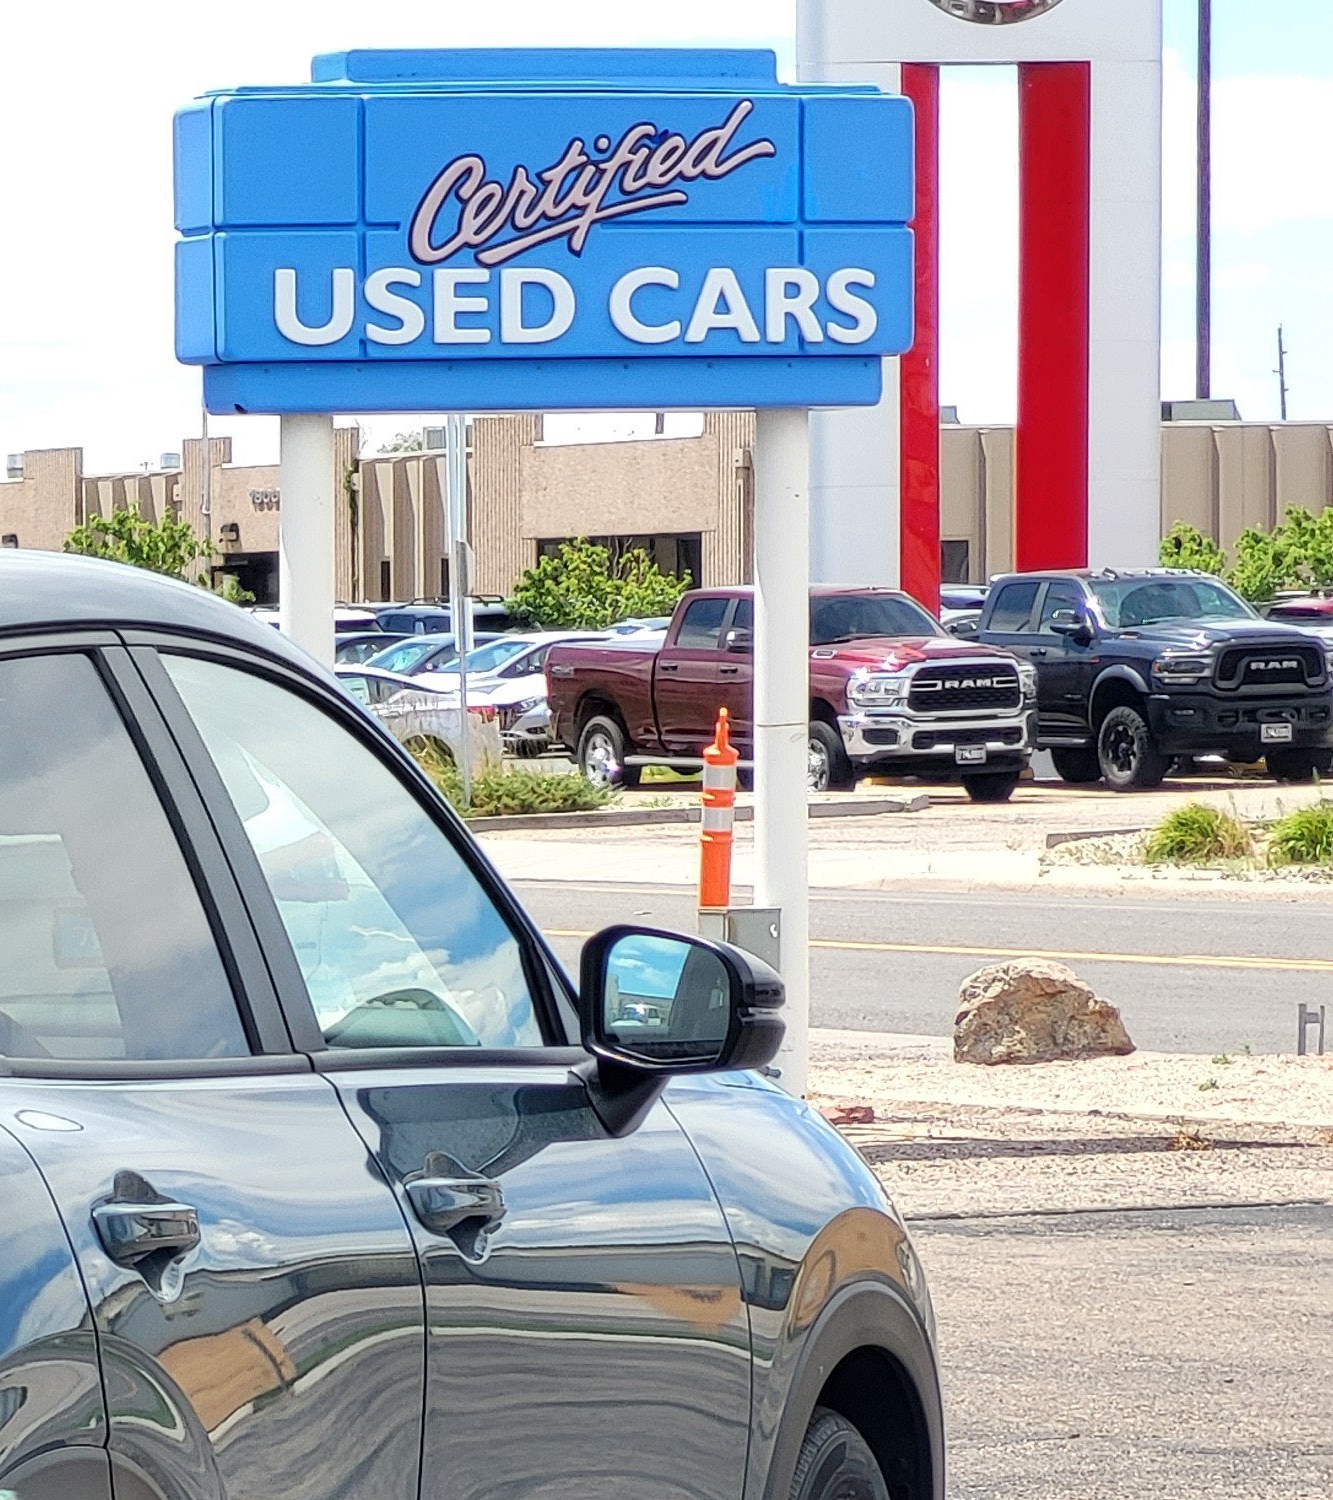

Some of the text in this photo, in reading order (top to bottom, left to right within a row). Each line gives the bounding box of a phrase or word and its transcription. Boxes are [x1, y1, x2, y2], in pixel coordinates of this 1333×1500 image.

[408, 100, 775, 266] Certified
[272, 265, 879, 347] USED CARS
[944, 678, 991, 689] RAM
[1250, 660, 1298, 670] RAM
